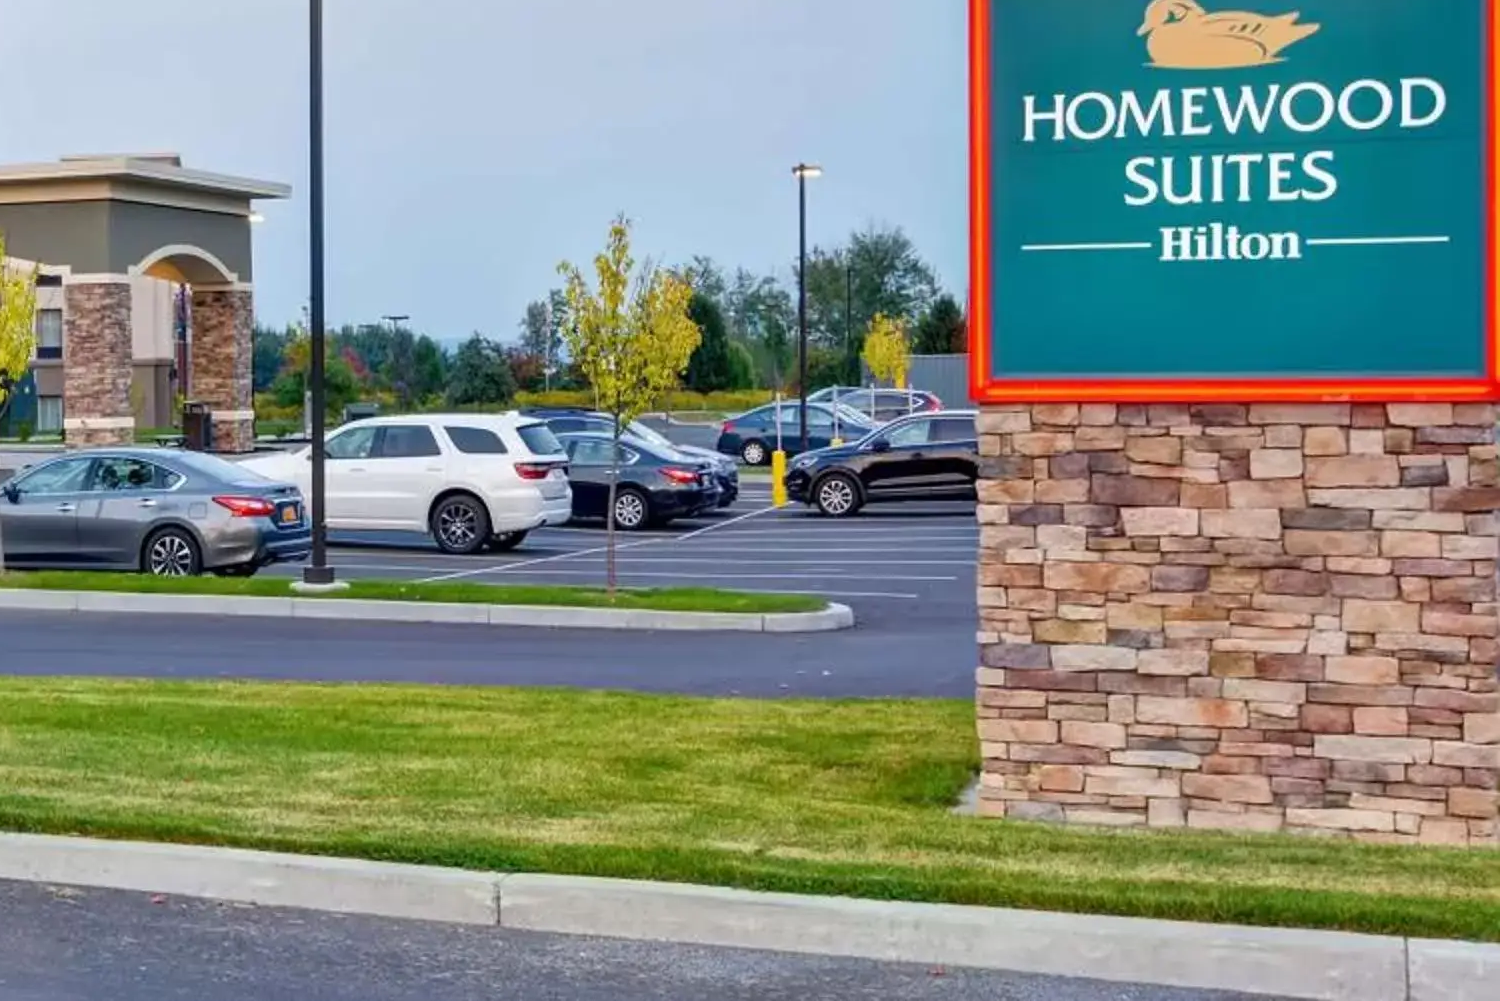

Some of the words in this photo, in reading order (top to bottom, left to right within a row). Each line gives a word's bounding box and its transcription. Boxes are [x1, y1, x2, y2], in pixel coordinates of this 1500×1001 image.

[1023, 77, 1446, 141] HOMEWOOD
[1123, 150, 1337, 205] SUITES
[1159, 222, 1302, 261] Hilton
